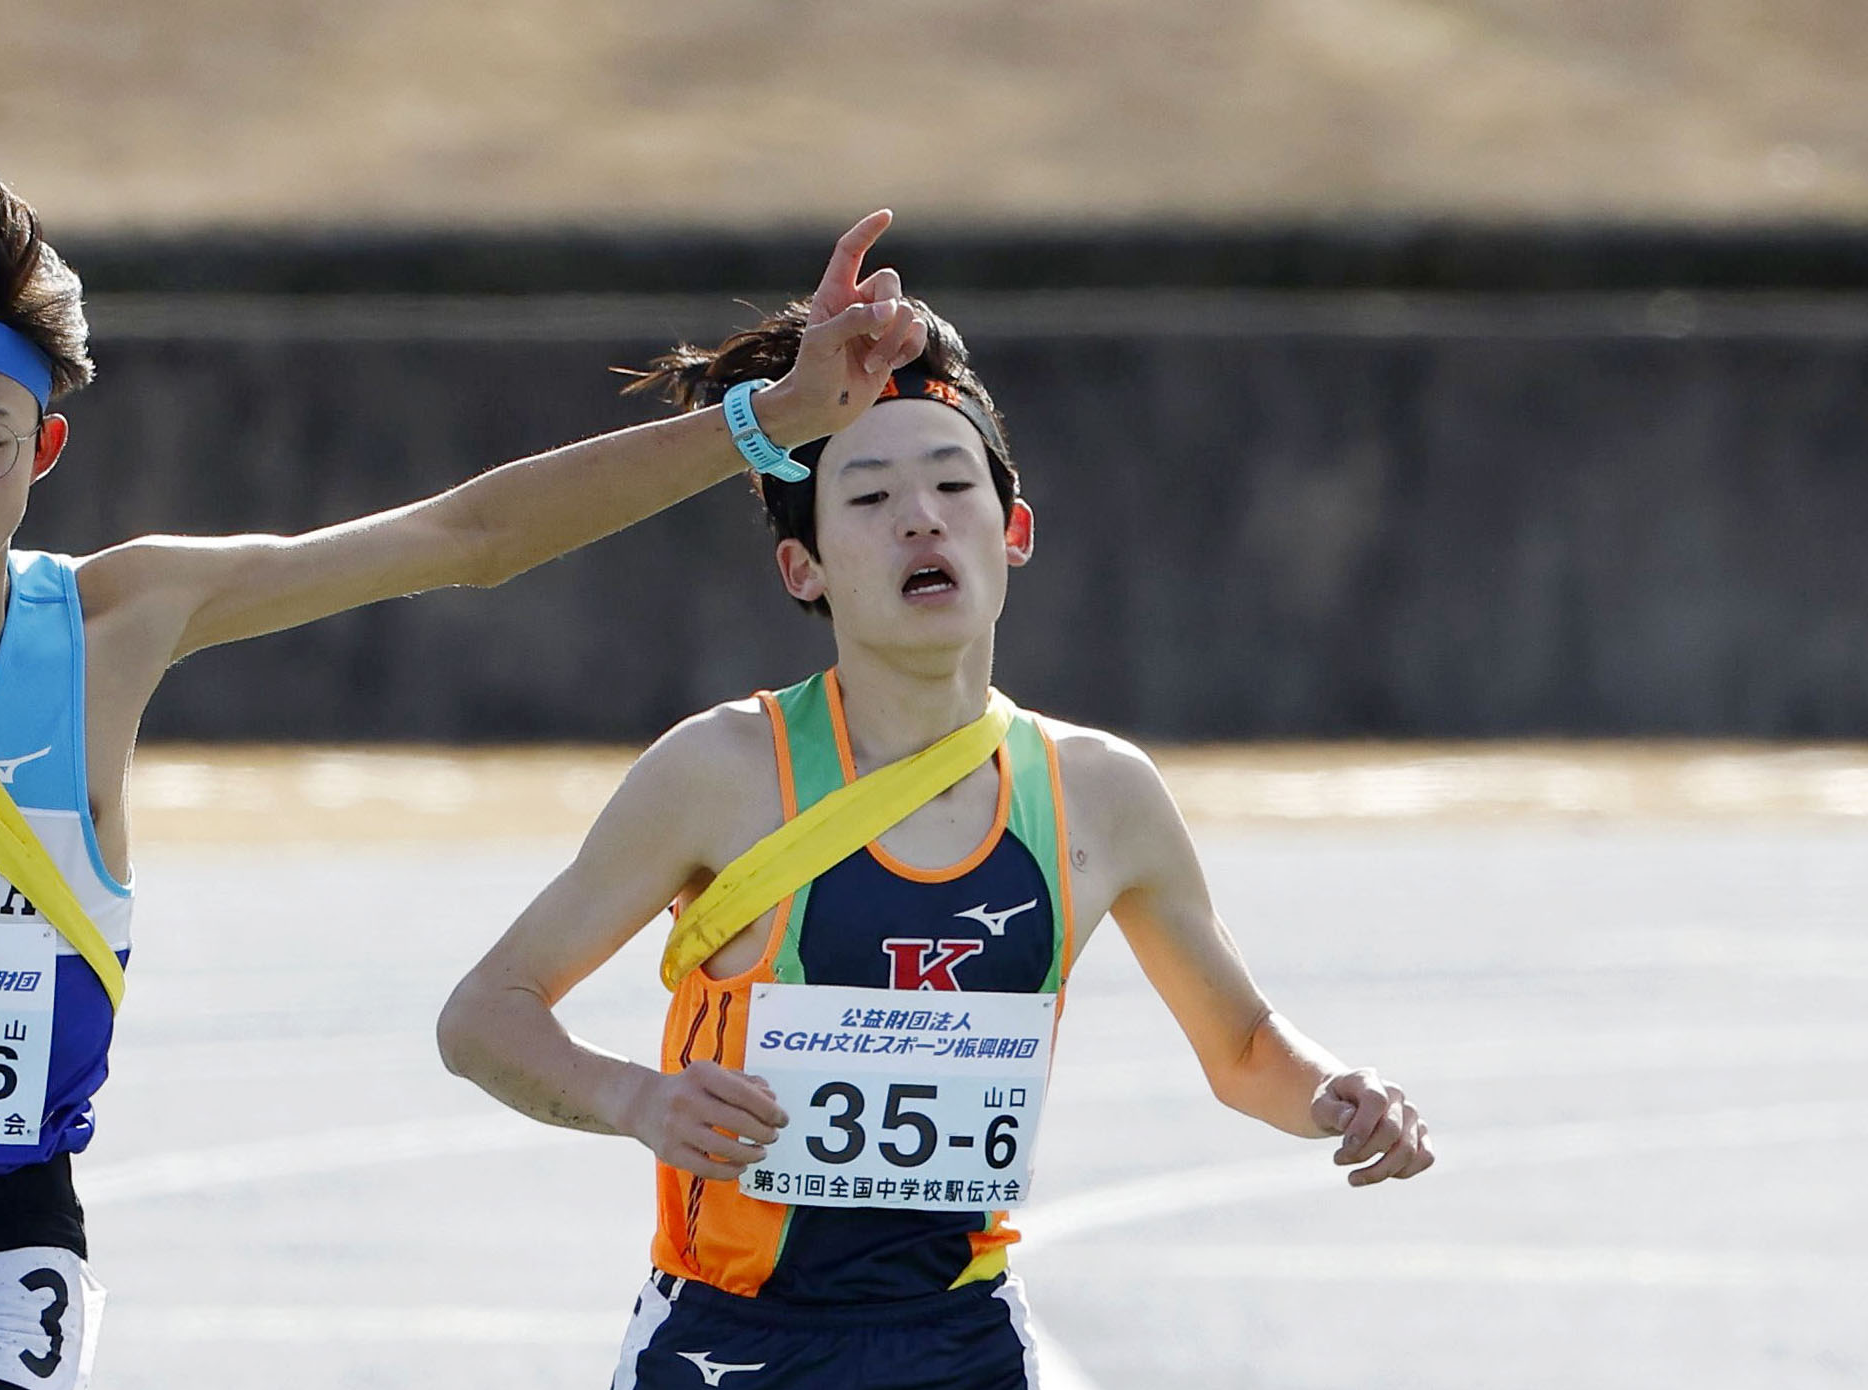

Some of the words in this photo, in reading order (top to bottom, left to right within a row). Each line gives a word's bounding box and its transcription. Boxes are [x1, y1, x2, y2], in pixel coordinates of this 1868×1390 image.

[840, 1007, 972, 1032] 公益財団法人
[758, 1030, 1040, 1059] SGH文化スポーツ振興財団
[983, 1086, 1027, 1109] 山口
[805, 1080, 1020, 1170] 35-6
[753, 1168, 1021, 1203] 第31回全国中学校駅伝大会
